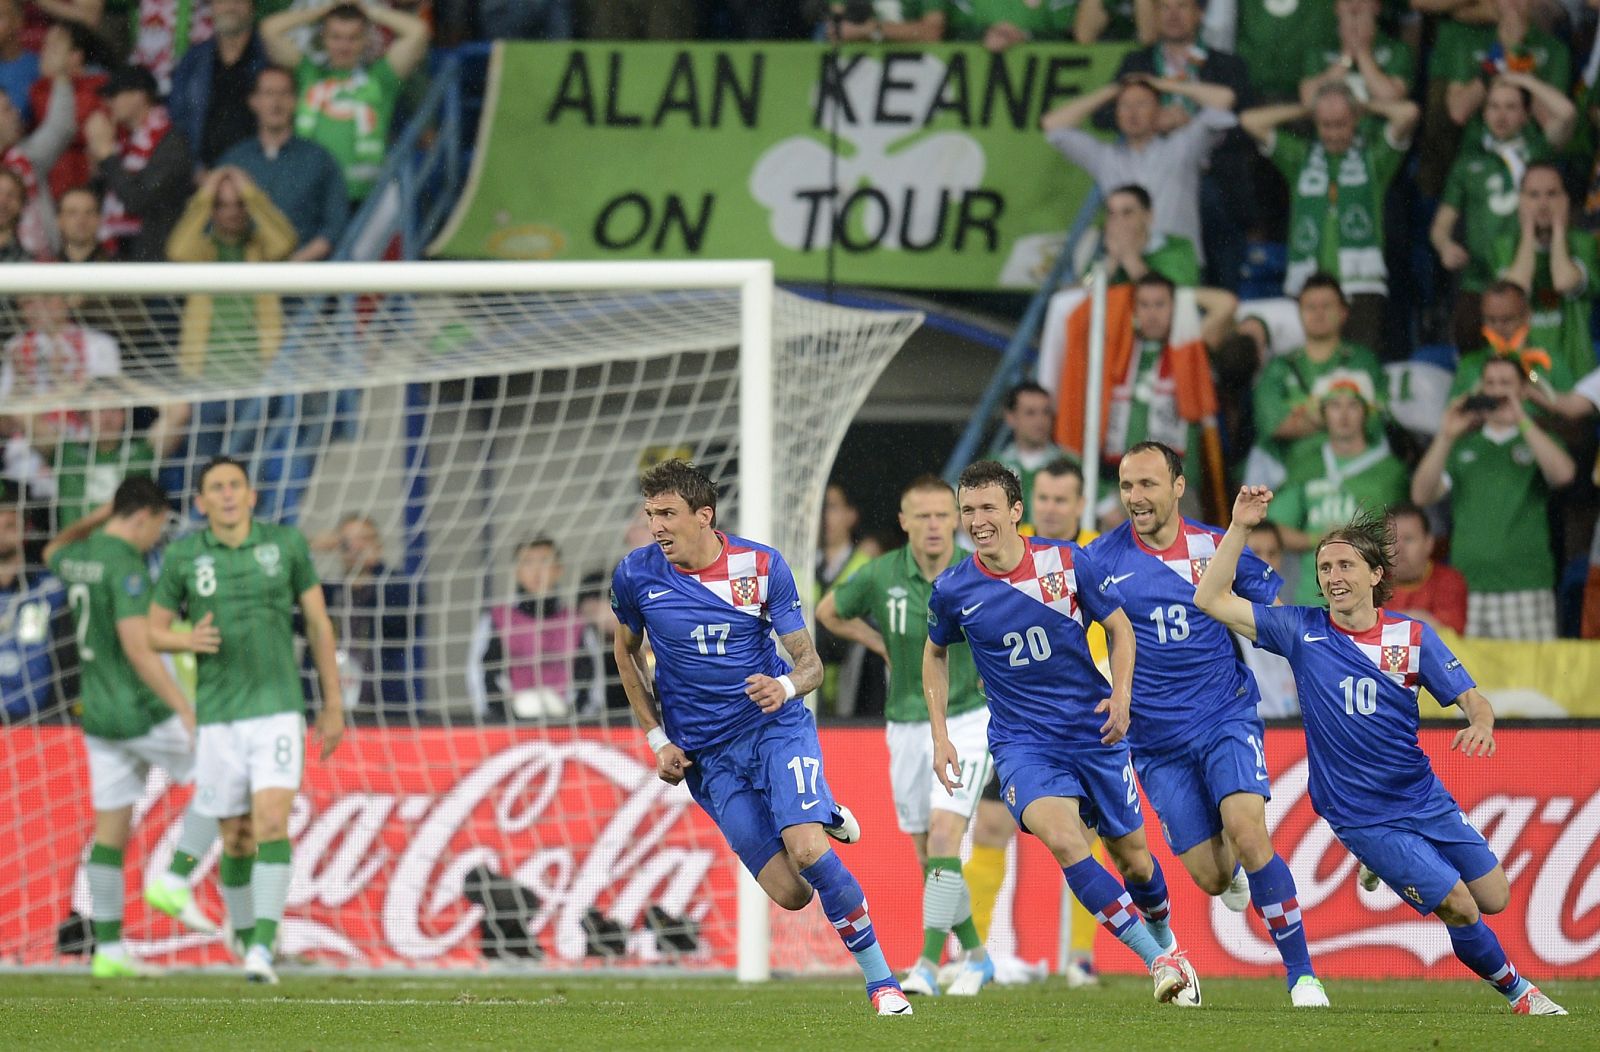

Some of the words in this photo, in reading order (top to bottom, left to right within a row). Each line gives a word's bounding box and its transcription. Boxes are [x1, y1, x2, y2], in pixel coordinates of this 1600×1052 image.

[545, 50, 764, 127] ALAN
[815, 53, 1091, 130] KEANE
[593, 192, 714, 253] ON
[795, 188, 1006, 253] TOUR
[195, 565, 217, 597] 8
[887, 597, 908, 635] 11
[1149, 604, 1191, 644] 13
[690, 623, 730, 655] 17
[1002, 625, 1052, 667] 20
[1338, 676, 1378, 716] 10
[275, 734, 292, 765] 8
[787, 756, 821, 795] 17
[1122, 756, 1140, 806] 2
